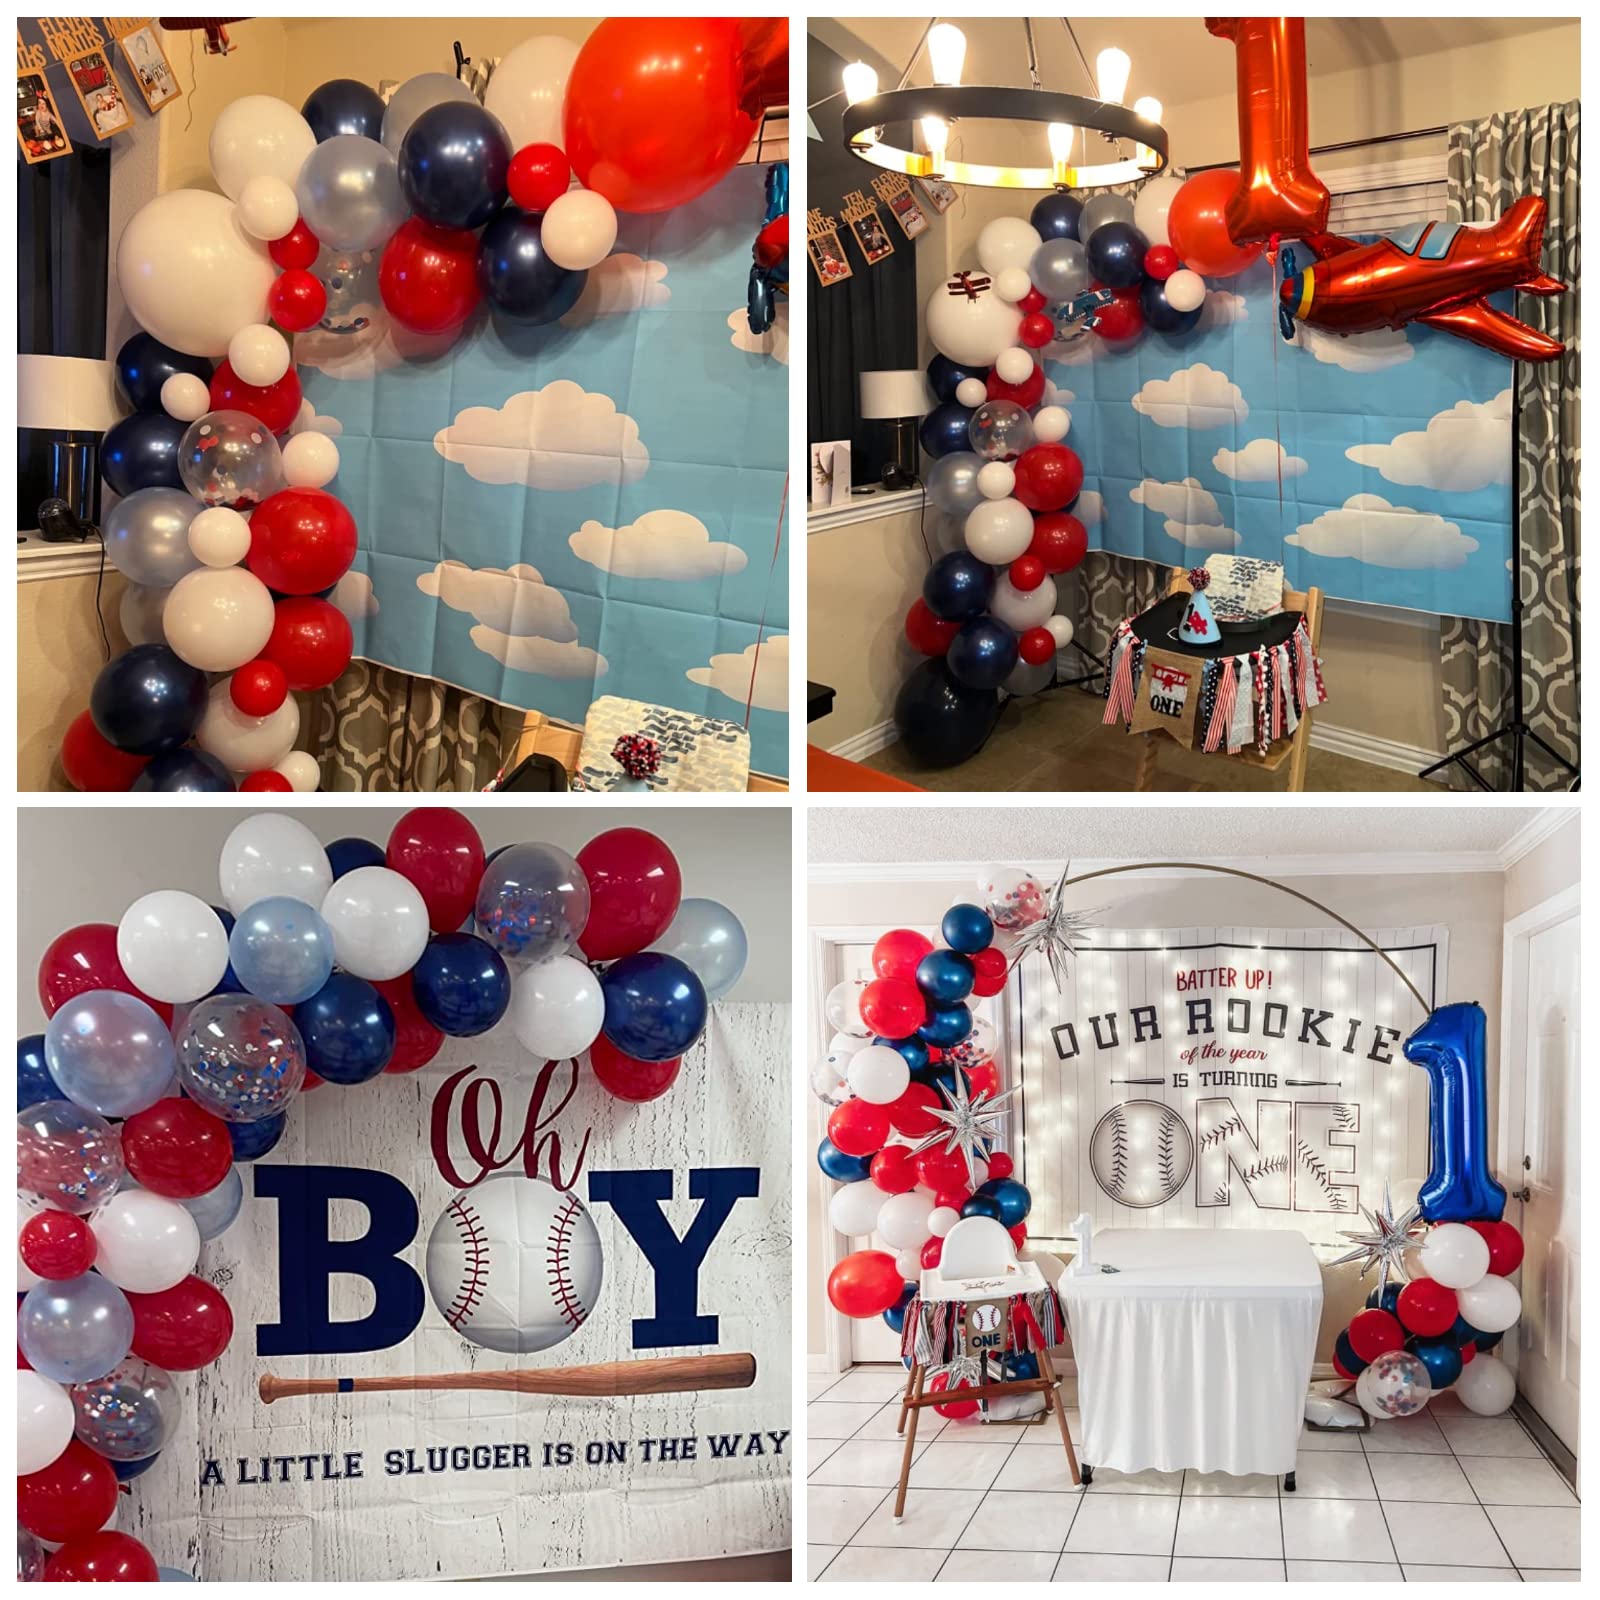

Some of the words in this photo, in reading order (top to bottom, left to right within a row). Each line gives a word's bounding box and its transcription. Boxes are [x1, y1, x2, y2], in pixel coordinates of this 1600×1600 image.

[1150, 695, 1184, 718] ONE
[1176, 967, 1237, 991] BATTER
[1050, 1004, 1162, 1060] OUR
[1185, 998, 1400, 1064] ROOKIE
[1180, 1046, 1199, 1065] of
[1201, 1040, 1227, 1059] the
[1229, 1048, 1268, 1064] year
[1172, 1073, 1189, 1088] IS
[1199, 1070, 1278, 1088] TURNING
[430, 1059, 591, 1193] Oh
[1402, 1002, 1507, 1224] 1
[1089, 1097, 1360, 1214] ONE
[253, 1164, 760, 1356] BOY
[972, 1333, 1001, 1348] ONE
[201, 1457, 225, 1485] A
[237, 1451, 364, 1484] LITTLE
[384, 1444, 532, 1476] SLUGGER
[543, 1442, 574, 1467] IS
[585, 1441, 627, 1465] ON
[638, 1437, 698, 1462] THE
[707, 1430, 791, 1459] WAY
